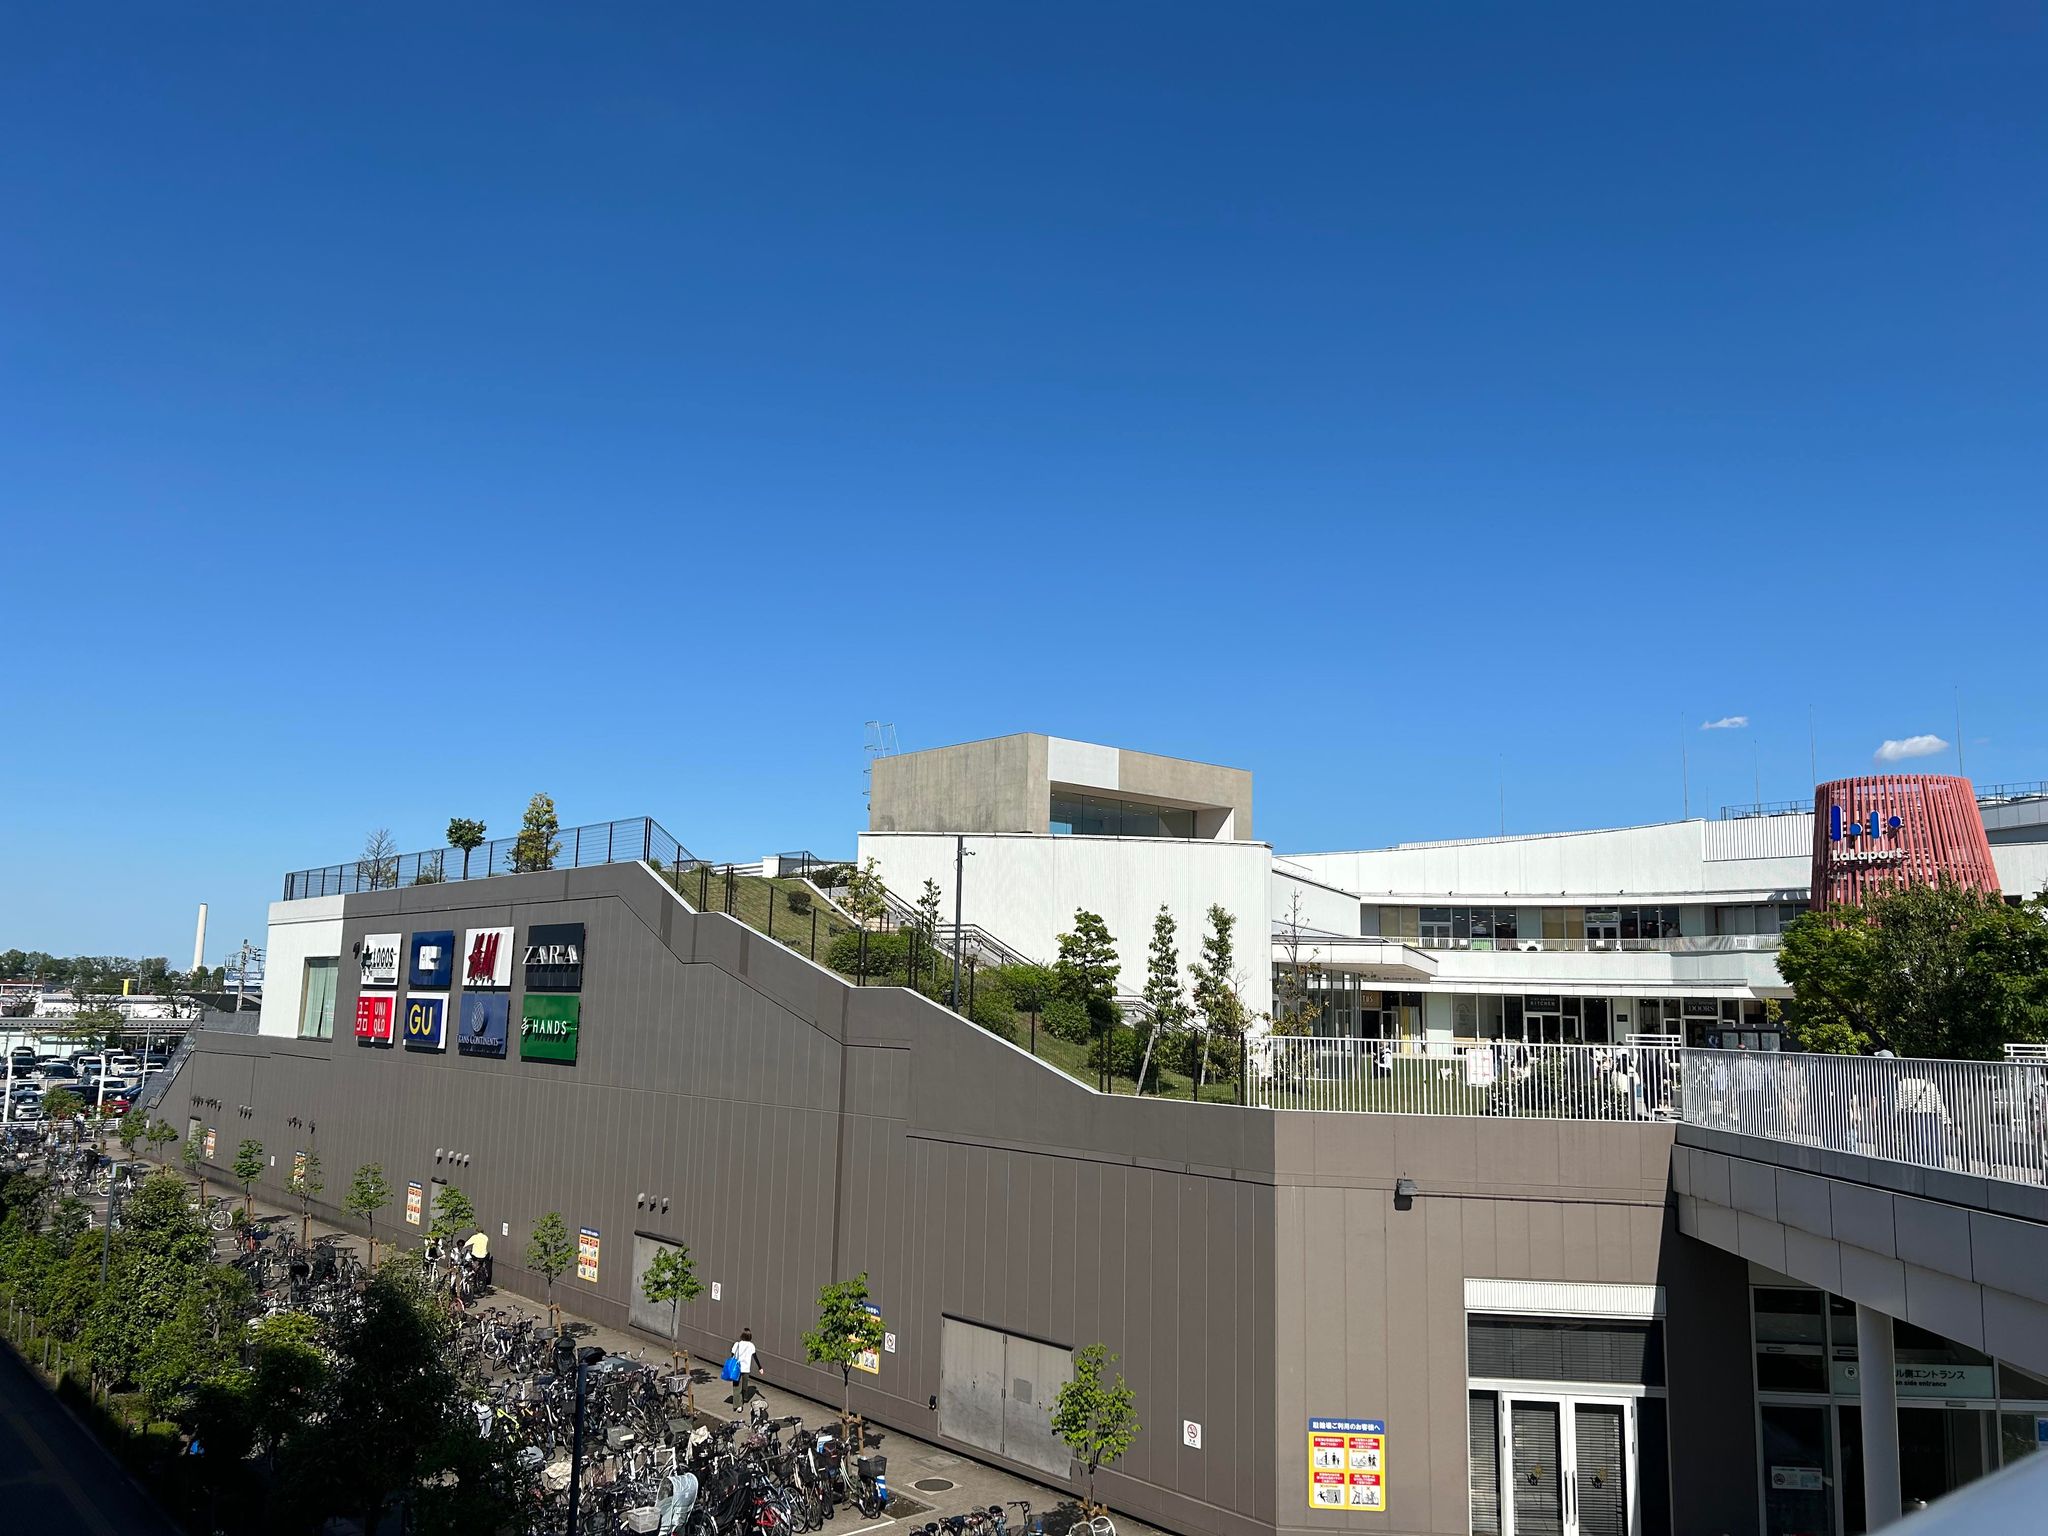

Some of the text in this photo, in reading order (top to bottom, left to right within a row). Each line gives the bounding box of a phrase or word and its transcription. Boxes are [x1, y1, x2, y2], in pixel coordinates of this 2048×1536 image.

[1832, 847, 1903, 863] LaLaport
[372, 947, 394, 968] LOGOS
[521, 944, 580, 965] ZARA
[374, 1002, 386, 1015] UNI
[373, 1018, 386, 1034] QLO
[409, 1004, 433, 1035] GU
[533, 1019, 568, 1035] HANDS
